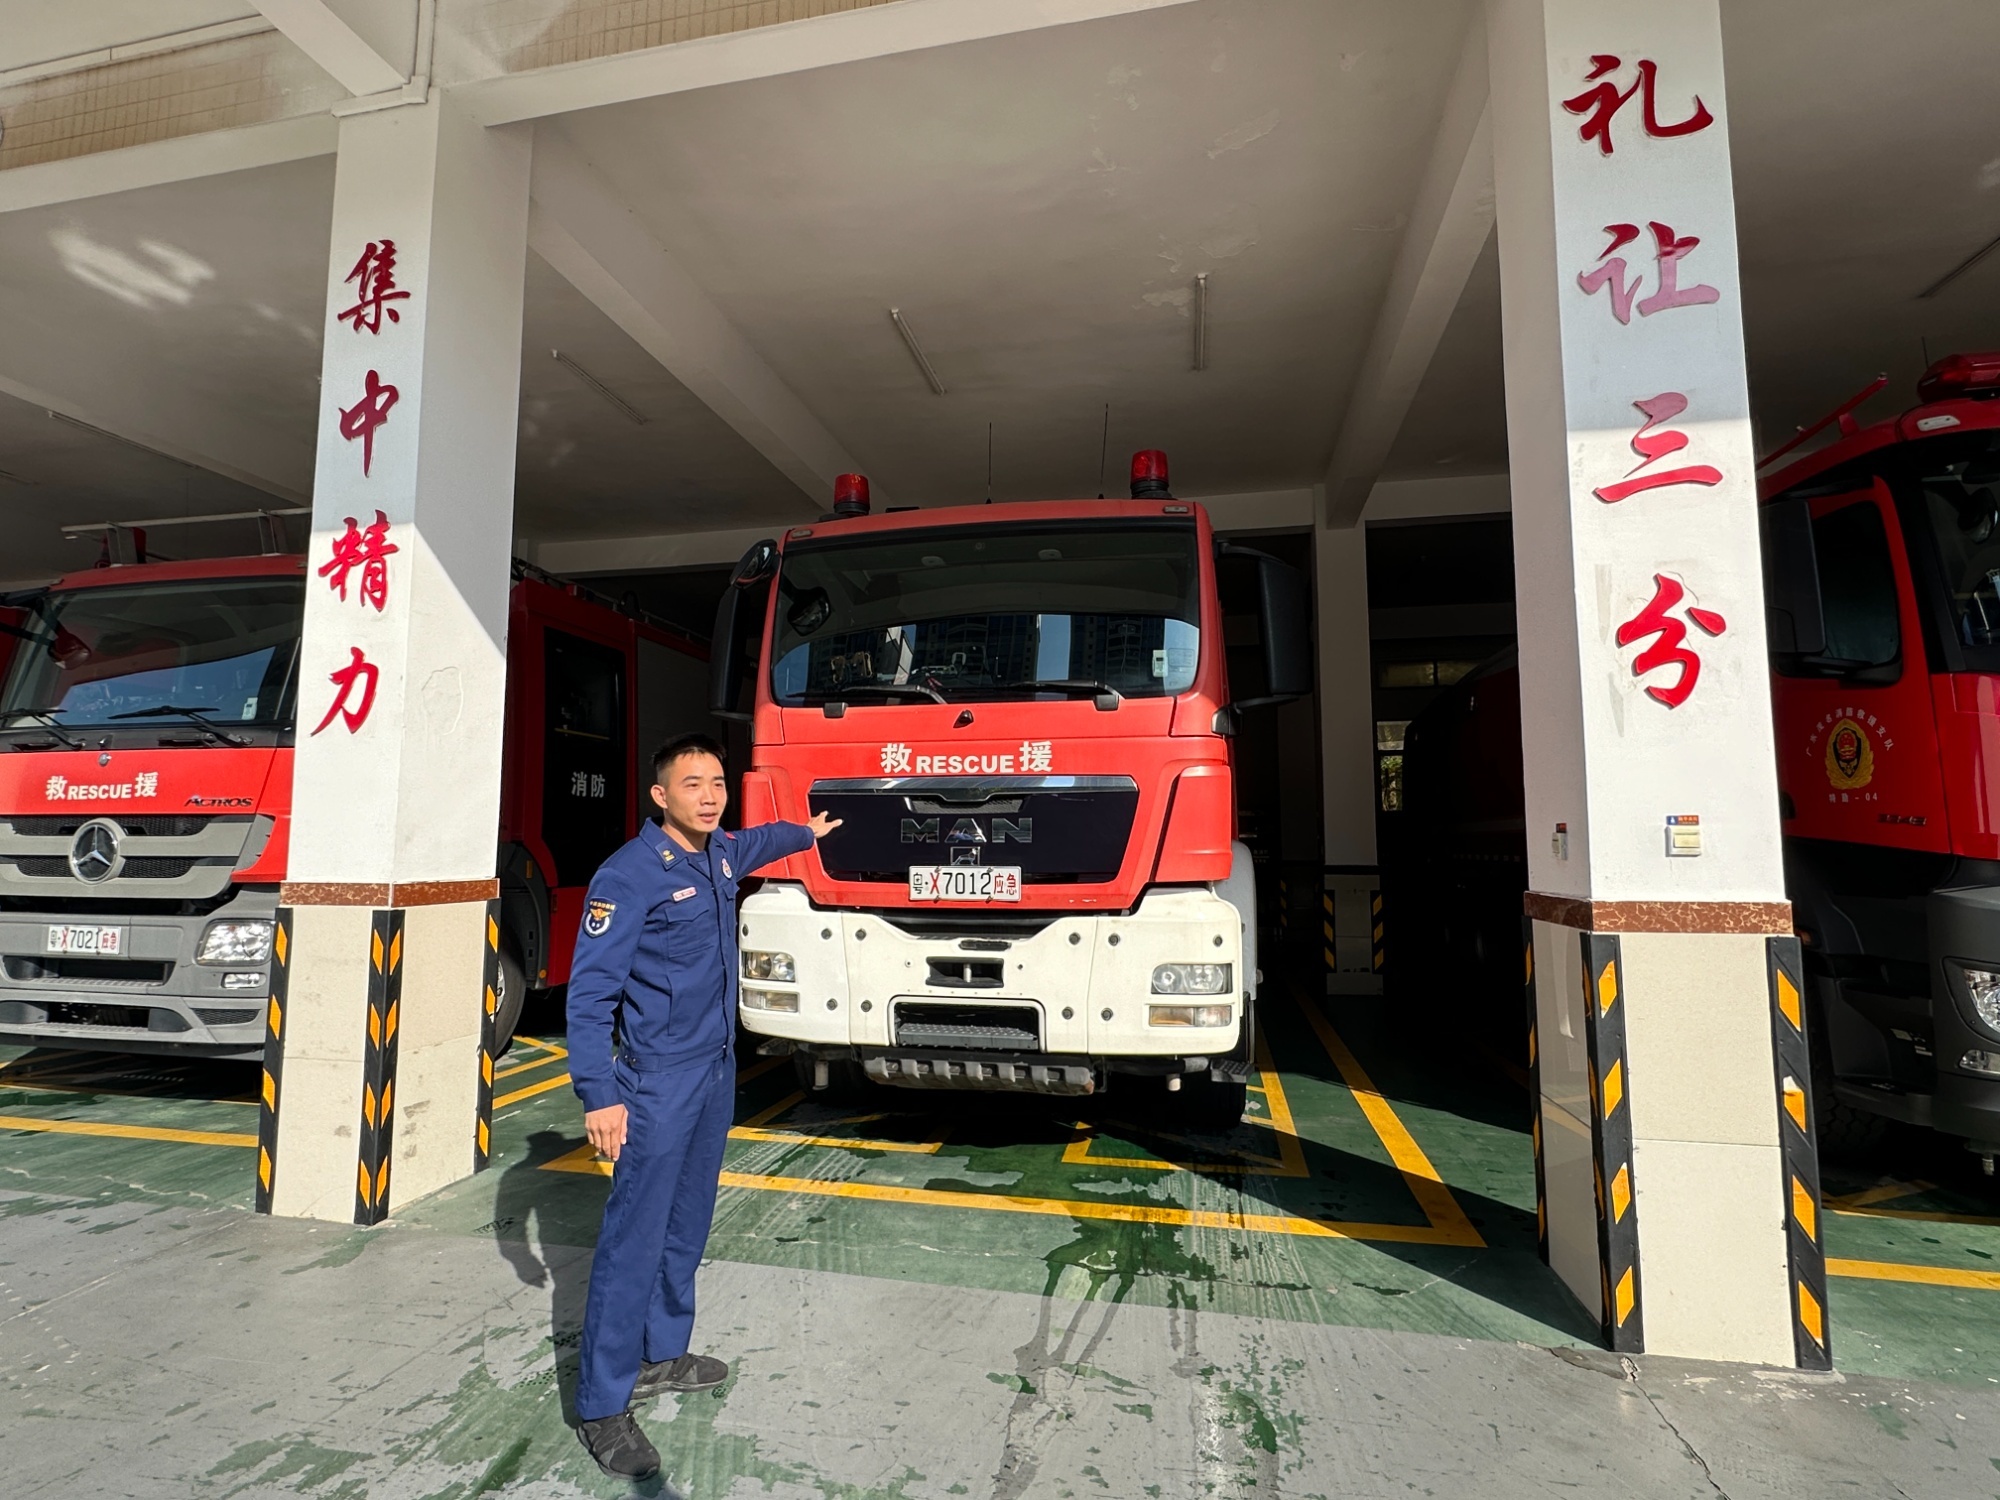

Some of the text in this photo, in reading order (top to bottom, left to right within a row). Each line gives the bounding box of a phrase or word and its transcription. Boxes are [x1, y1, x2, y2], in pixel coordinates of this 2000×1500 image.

[1561, 54, 1727, 710] 礼让三分
[311, 239, 411, 737] 集中精力
[881, 740, 1053, 774] 救 RESCUE 援
[45, 771, 158, 800] 救 RESCUE 援
[571, 770, 606, 798] 消防
[900, 817, 1033, 843] MAN
